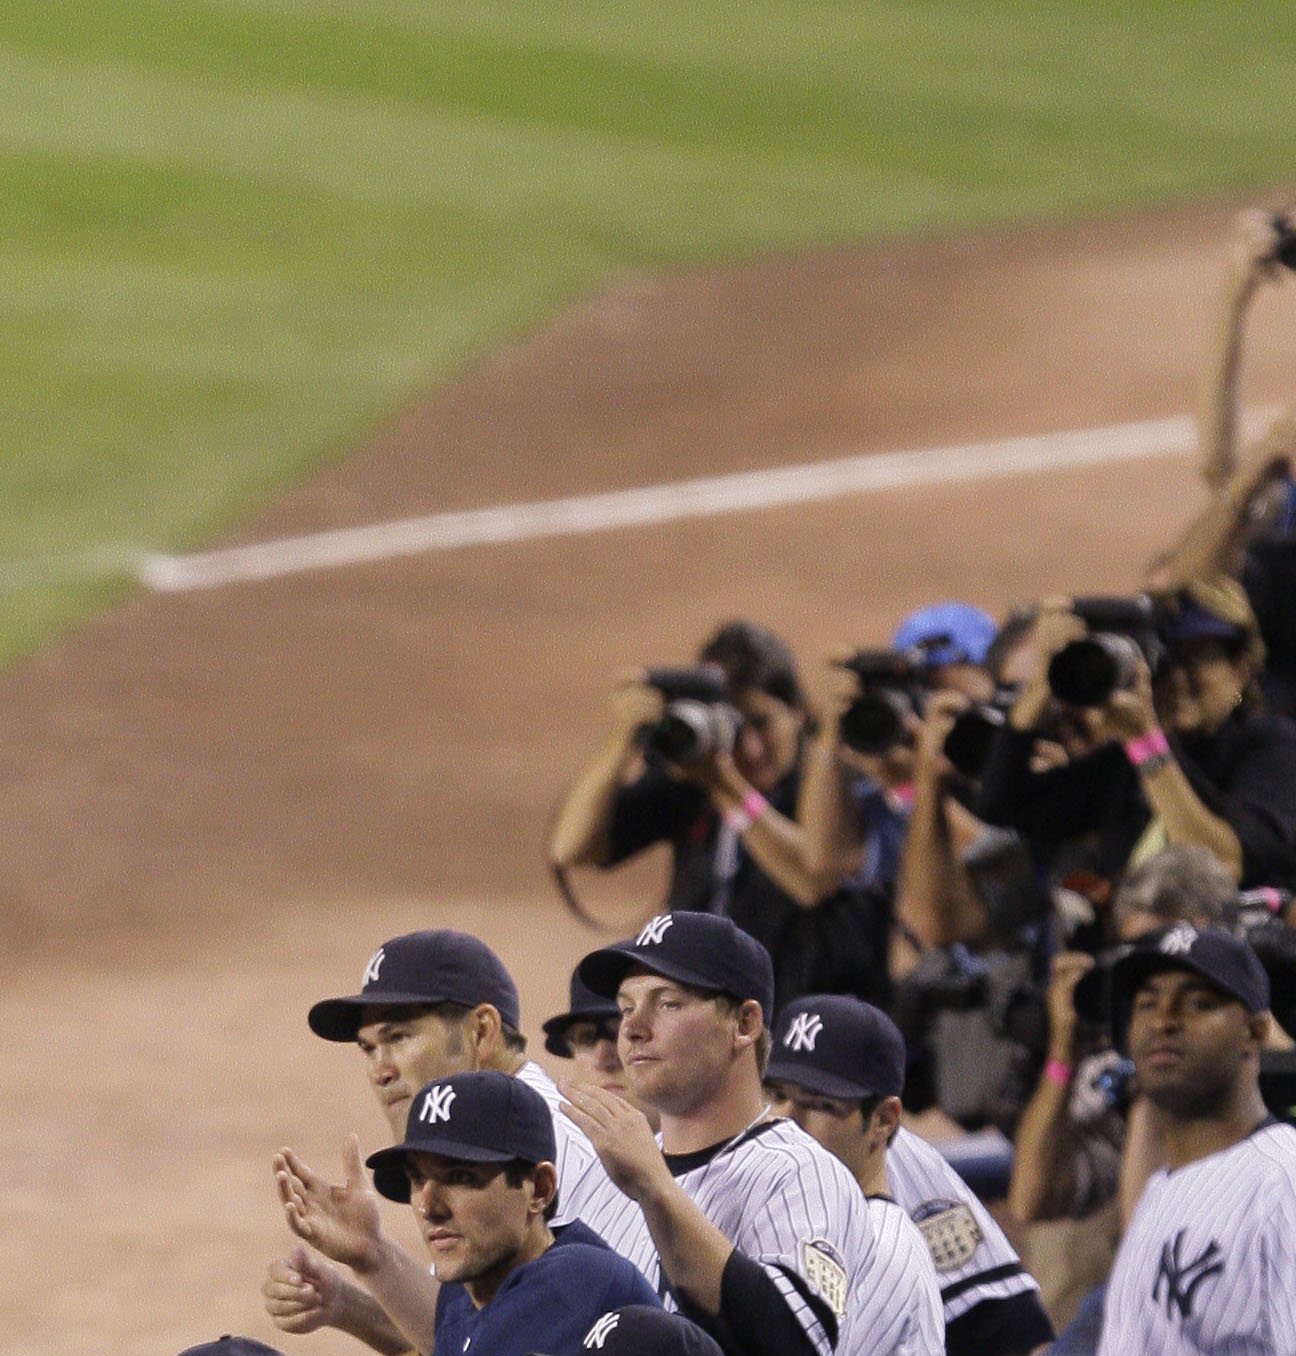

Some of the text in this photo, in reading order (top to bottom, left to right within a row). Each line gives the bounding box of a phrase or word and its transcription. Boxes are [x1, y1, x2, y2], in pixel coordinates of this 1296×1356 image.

[636, 914, 673, 946] NY
[784, 1012, 823, 1051] NY
[419, 1085, 456, 1124] NY
[1153, 1229, 1224, 1320] NY
[583, 1312, 621, 1349] NY
